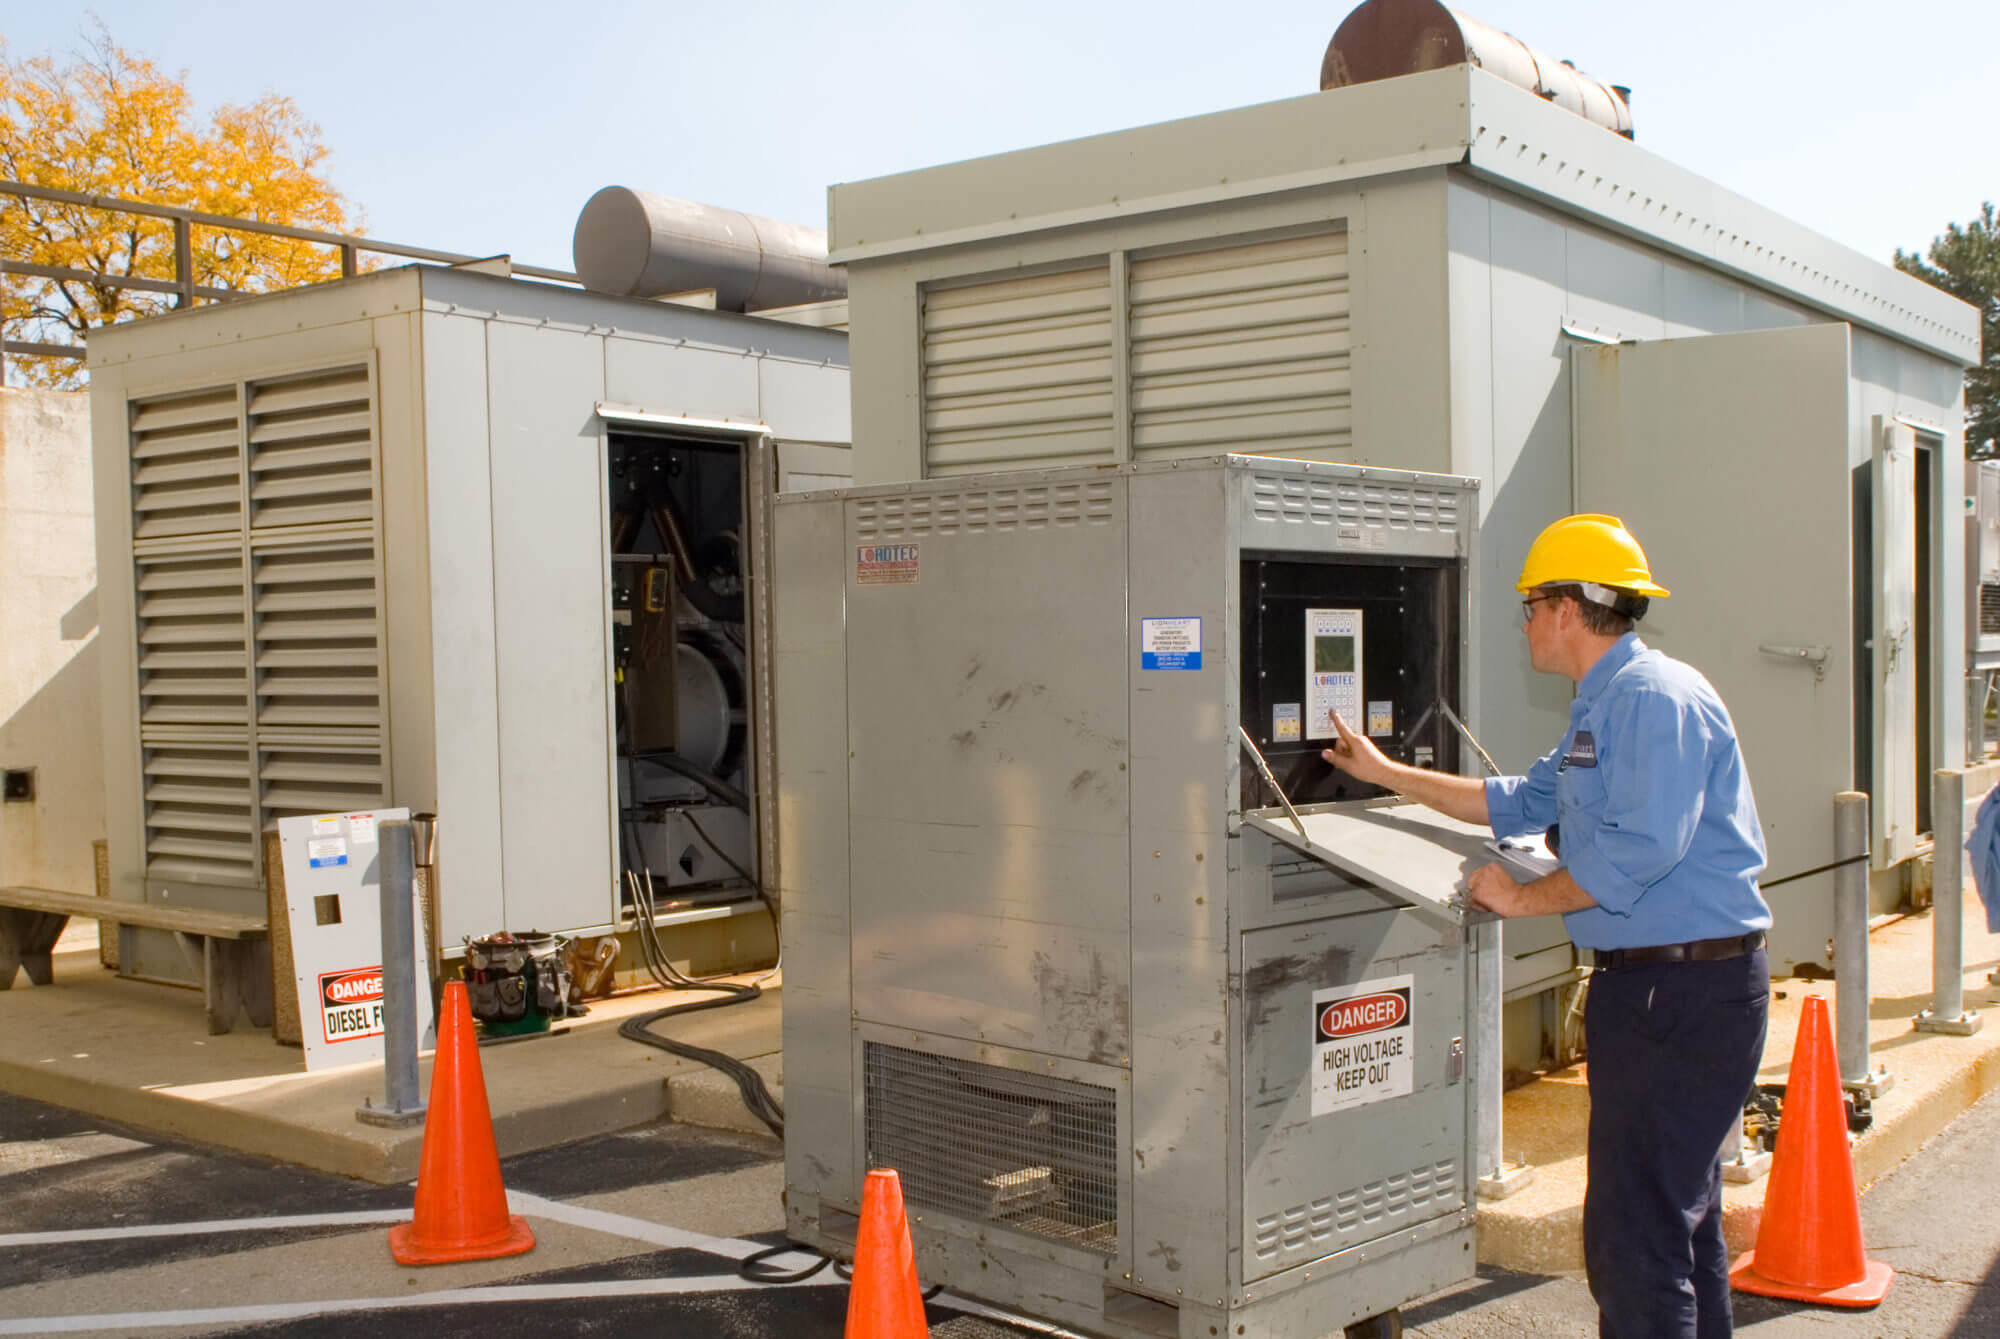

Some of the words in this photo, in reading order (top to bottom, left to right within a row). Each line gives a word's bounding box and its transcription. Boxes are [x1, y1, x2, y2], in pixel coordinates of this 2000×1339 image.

[857, 546, 918, 562] LOADTEC
[1314, 674, 1354, 686] LOADTEC
[332, 977, 383, 999] DANGE
[327, 1008, 371, 1034] DIESEL
[1330, 999, 1397, 1032] DANGER
[1323, 1047, 1350, 1072] HIGH
[1353, 1036, 1403, 1065] VOLTAGE
[1336, 1067, 1366, 1093] KEEP
[1368, 1062, 1391, 1085] OUT
